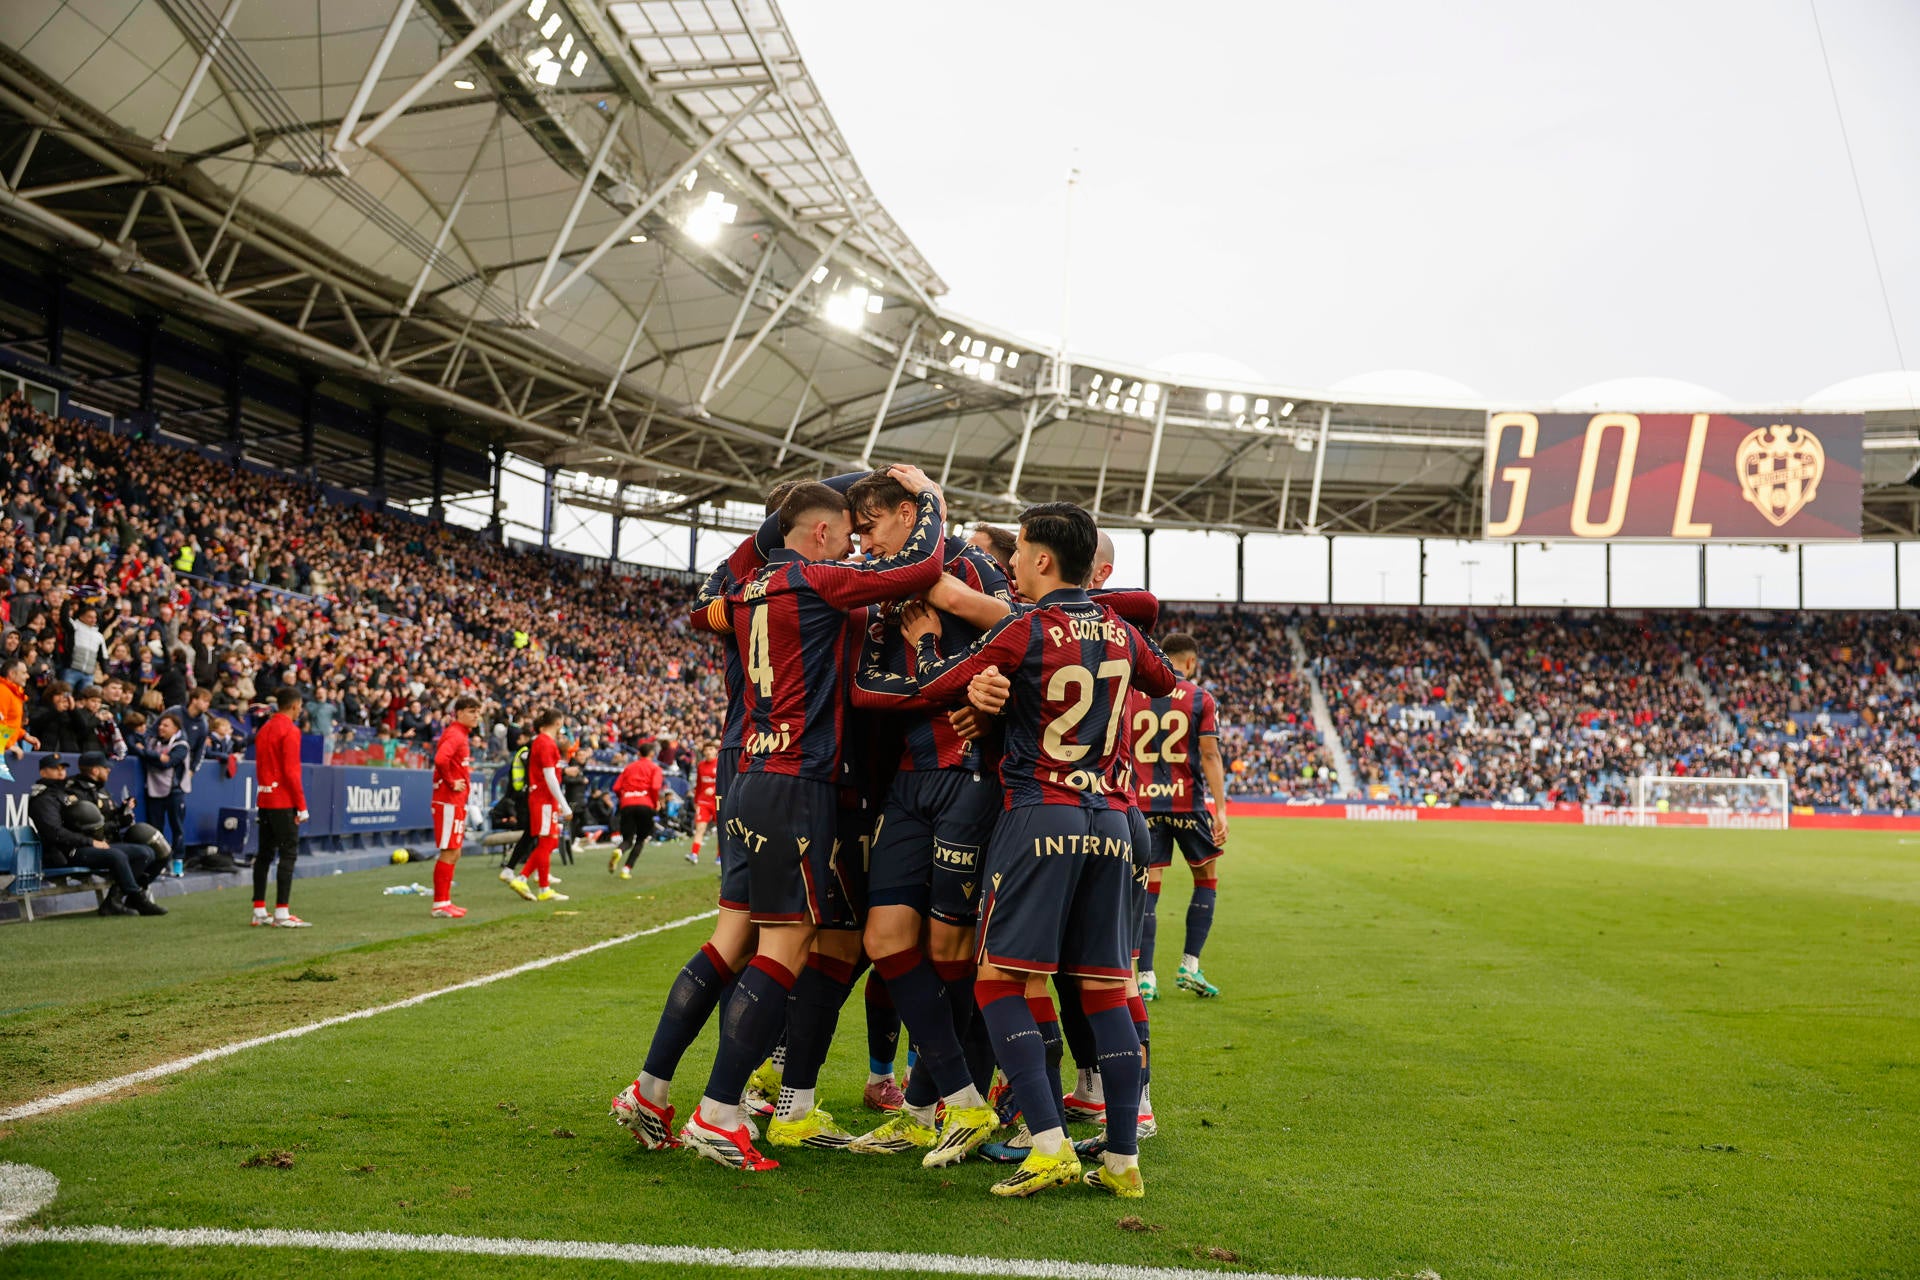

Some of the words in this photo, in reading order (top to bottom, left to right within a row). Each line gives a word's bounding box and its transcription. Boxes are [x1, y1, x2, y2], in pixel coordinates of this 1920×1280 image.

[748, 603, 775, 698] 4
[1046, 658, 1132, 763] 27
[1132, 709, 1190, 764] 22
[935, 846, 975, 866] JYSK
[1034, 834, 1133, 862] INTERNX
